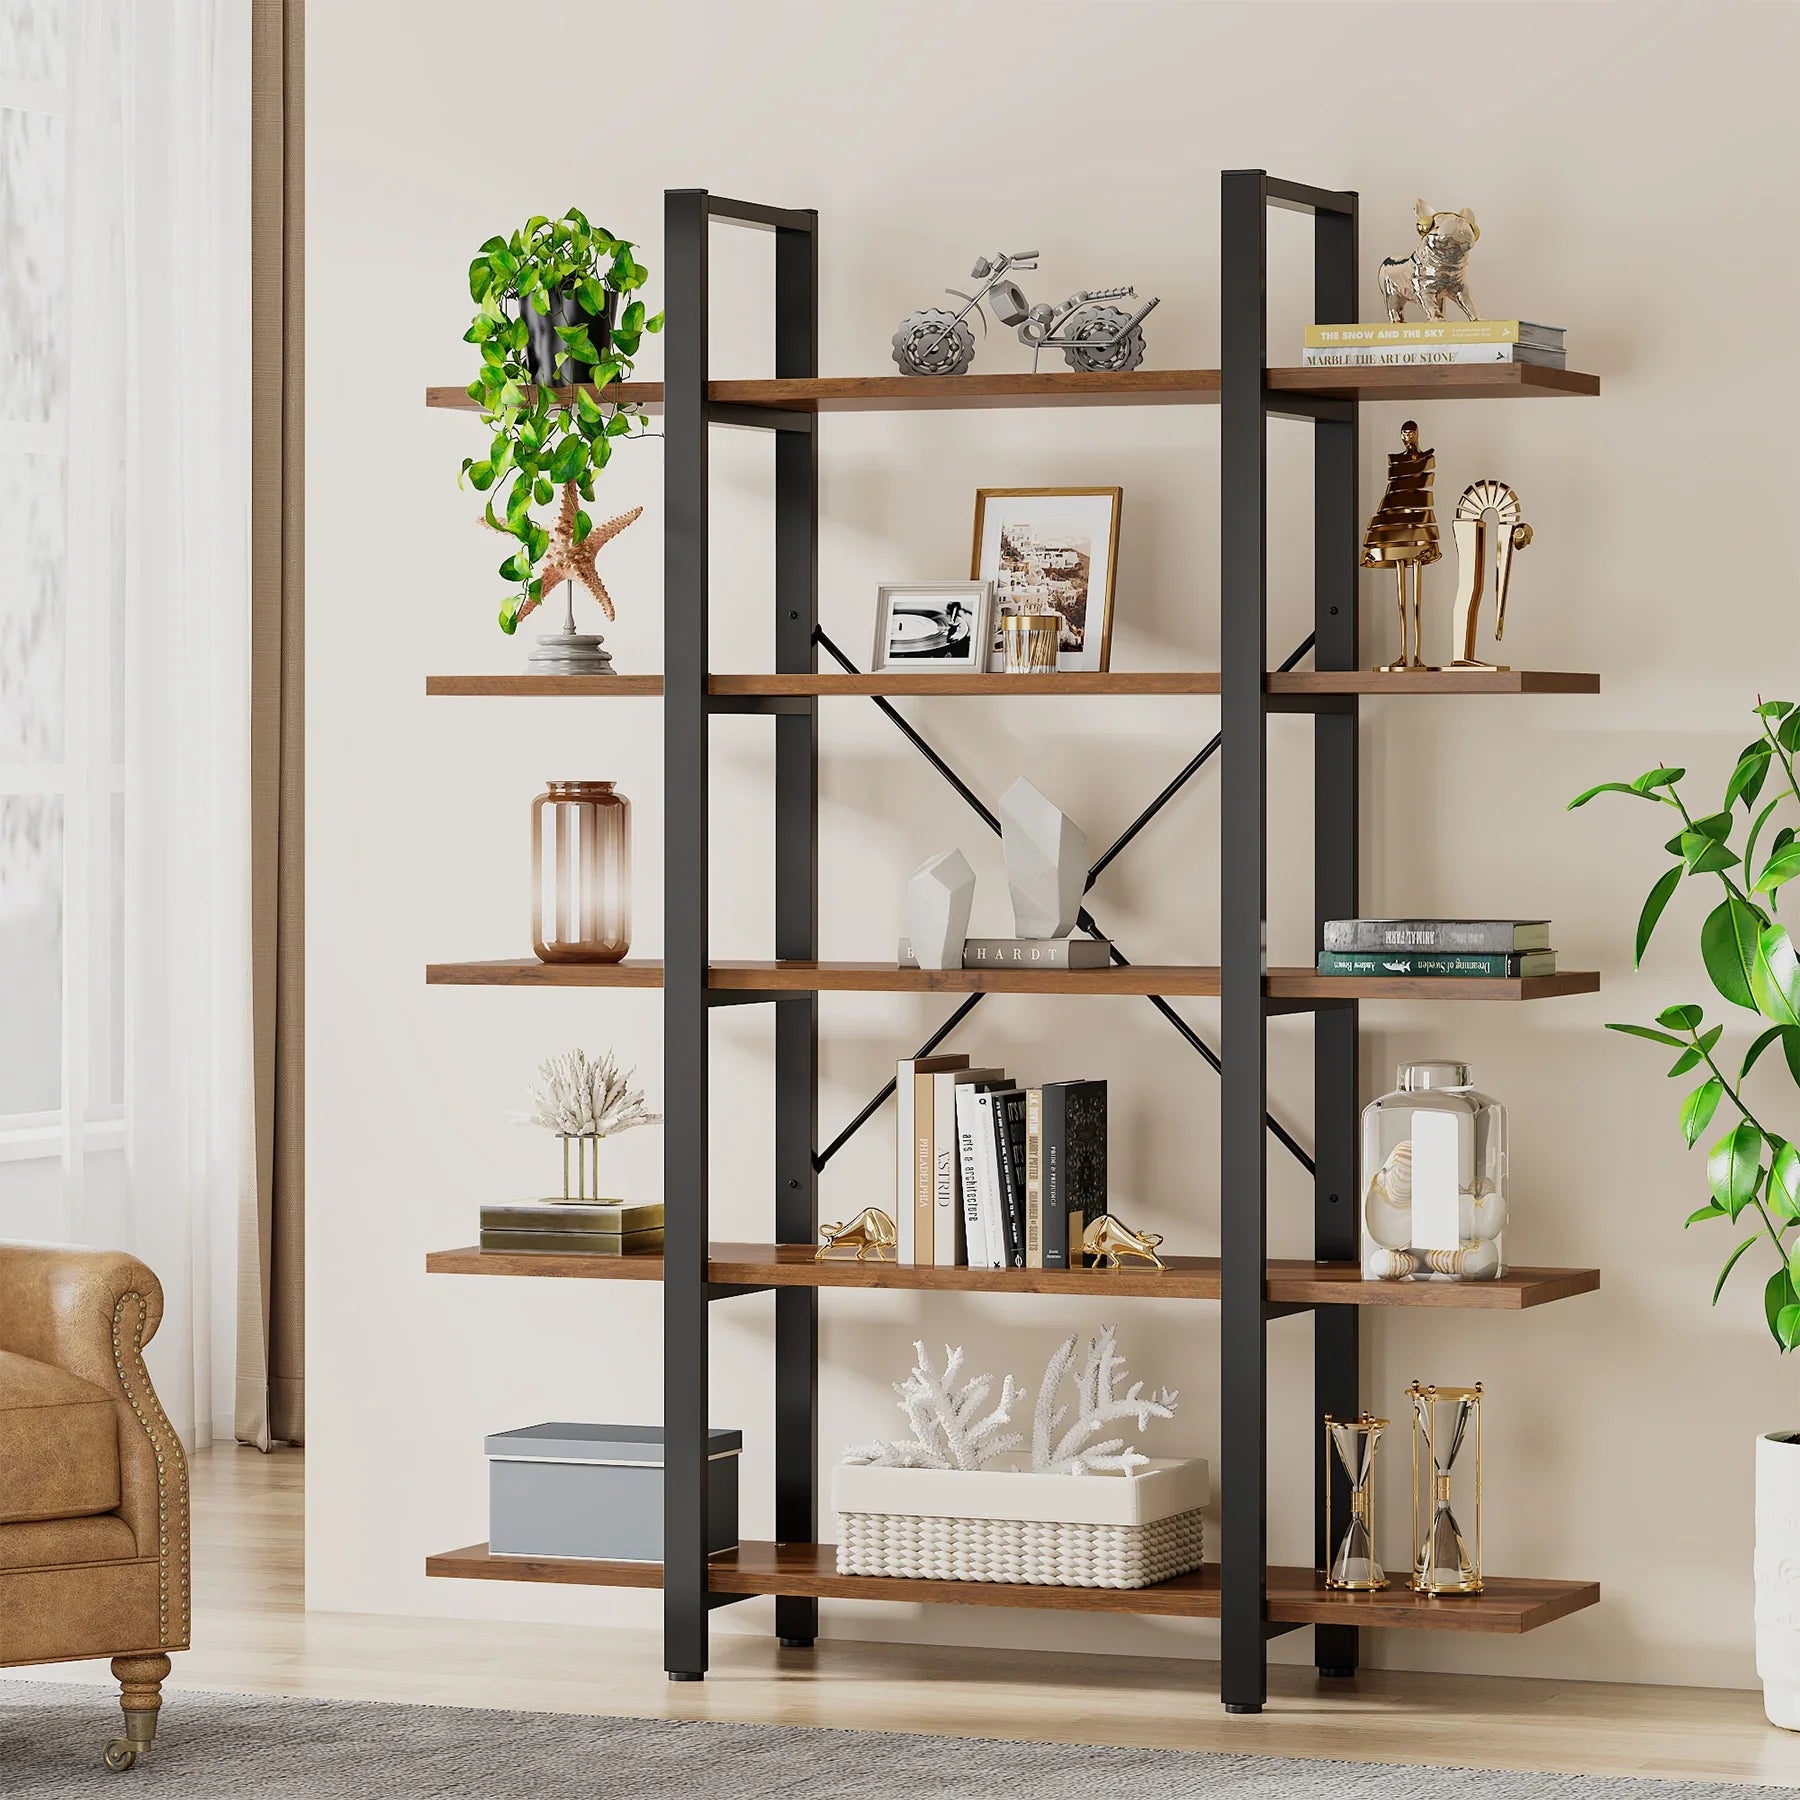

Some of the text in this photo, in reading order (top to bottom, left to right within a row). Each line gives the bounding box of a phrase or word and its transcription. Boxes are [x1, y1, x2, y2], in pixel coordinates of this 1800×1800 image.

[1321, 331, 1340, 341] THE
[1342, 330, 1374, 340] SNOW
[1377, 330, 1400, 340] AND
[1403, 329, 1421, 338] THE
[1424, 328, 1445, 338] SKY
[1307, 351, 1456, 366] MARBLE THE ART OF STONE
[1385, 930, 1406, 944] FARM
[1406, 930, 1435, 945] ANIMAL
[1353, 961, 1376, 972] Andrew
[1417, 957, 1490, 974] Dreaming of Sweden
[962, 1134, 974, 1152] arts
[1029, 1136, 1039, 1156] HARRY
[918, 1137, 928, 1207] PHILADELPHIA
[1029, 1157, 1039, 1180] POTTER
[965, 1166, 979, 1222] architecture
[1029, 1191, 1039, 1220] CHAMBER
[1029, 1225, 1039, 1251] SECRETS
